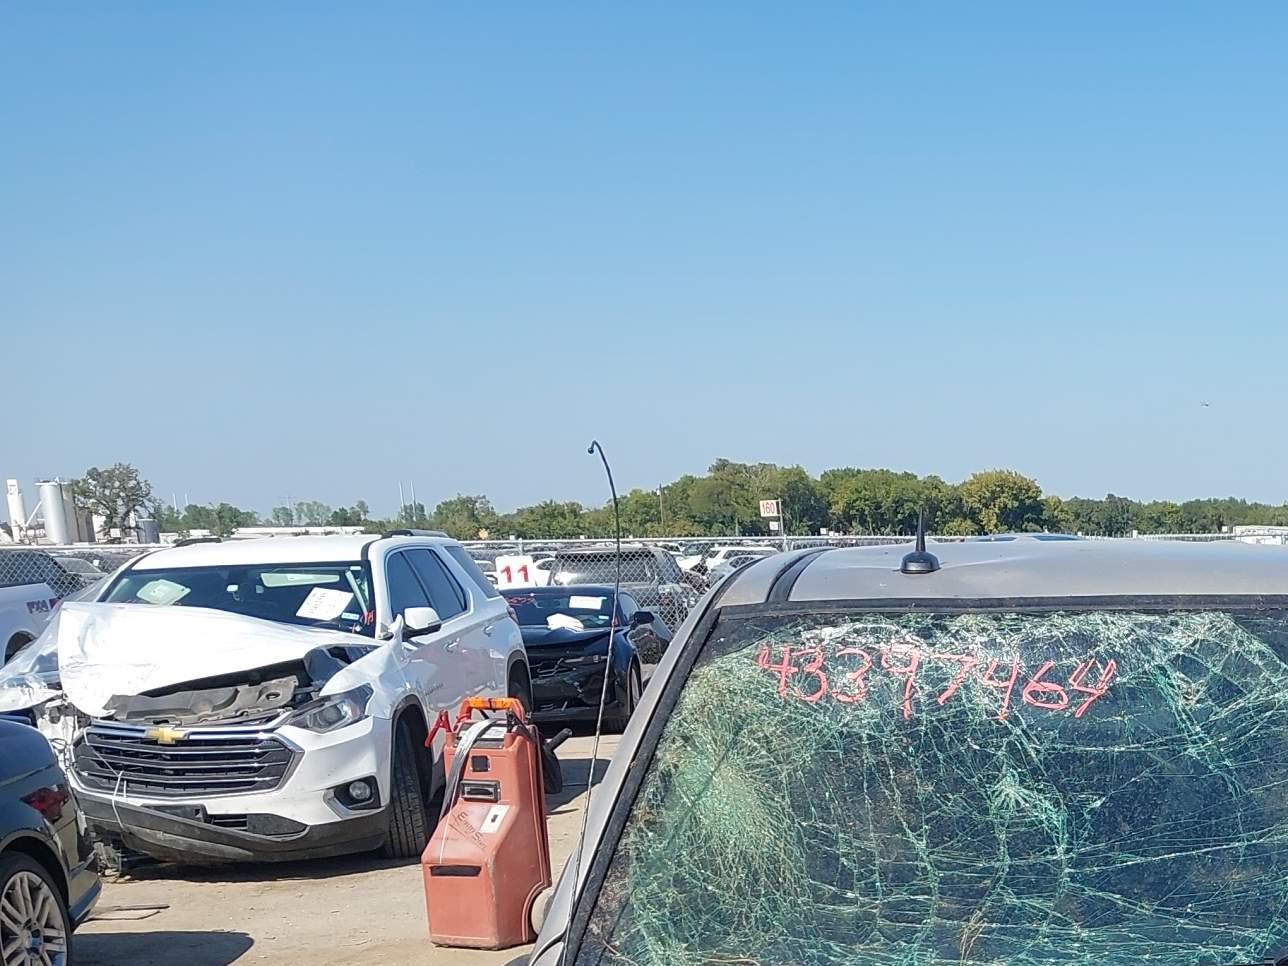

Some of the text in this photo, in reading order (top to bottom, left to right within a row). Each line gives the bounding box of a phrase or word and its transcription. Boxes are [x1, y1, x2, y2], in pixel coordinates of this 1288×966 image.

[762, 501, 776, 515] 160
[501, 564, 529, 583] 11
[758, 644, 1117, 722] 43397464
